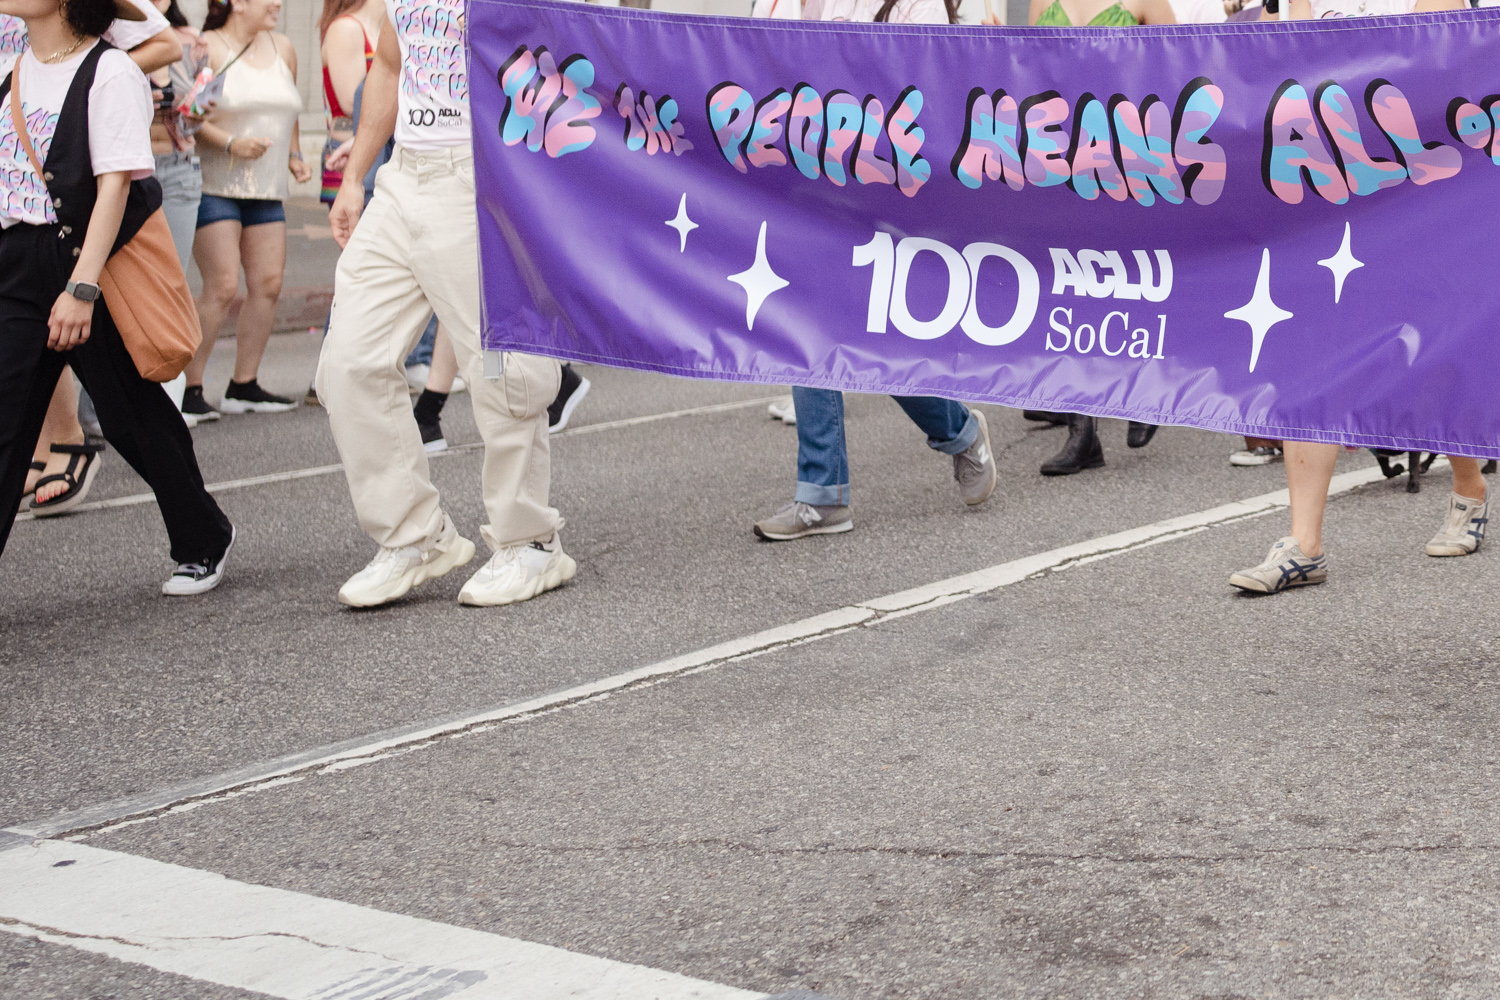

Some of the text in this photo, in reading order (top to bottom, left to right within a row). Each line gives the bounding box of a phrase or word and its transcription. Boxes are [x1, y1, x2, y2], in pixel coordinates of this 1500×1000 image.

[405, 43, 463, 72] MEANS
[408, 108, 436, 127] 100
[437, 117, 463, 128] SoCal
[497, 44, 602, 159] WE
[612, 81, 695, 157] THE
[706, 80, 932, 198] PEOPLE
[950, 76, 1228, 207] MEANS
[1261, 78, 1463, 206] ALL
[852, 231, 1174, 347] 100 ACLU
[1045, 305, 1168, 360] SoCal
